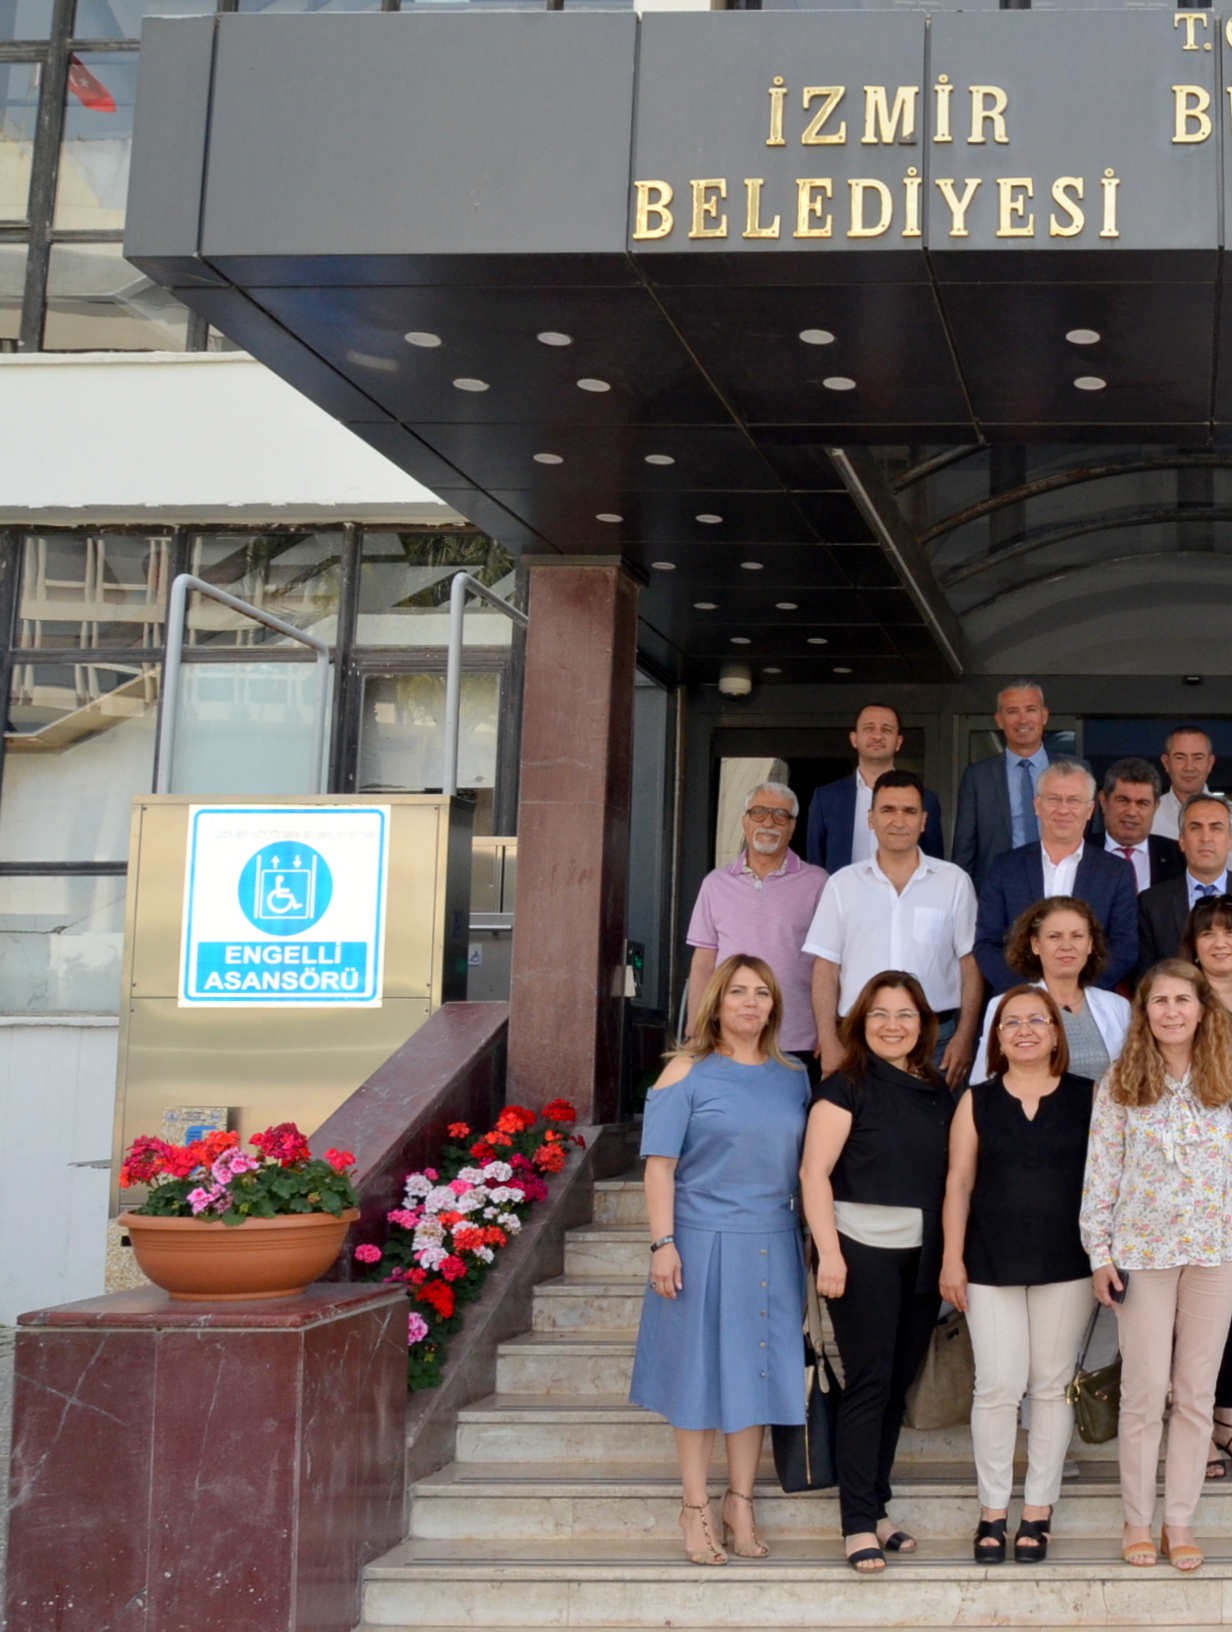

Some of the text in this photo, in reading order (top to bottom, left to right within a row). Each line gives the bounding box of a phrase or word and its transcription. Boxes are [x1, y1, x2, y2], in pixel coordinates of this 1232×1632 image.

[766, 75, 1011, 149] İZMİR
[632, 167, 1123, 244] BELEDİYESİ
[224, 942, 342, 965] ENGELLİ
[203, 967, 360, 990] ASANSÖRÜ
